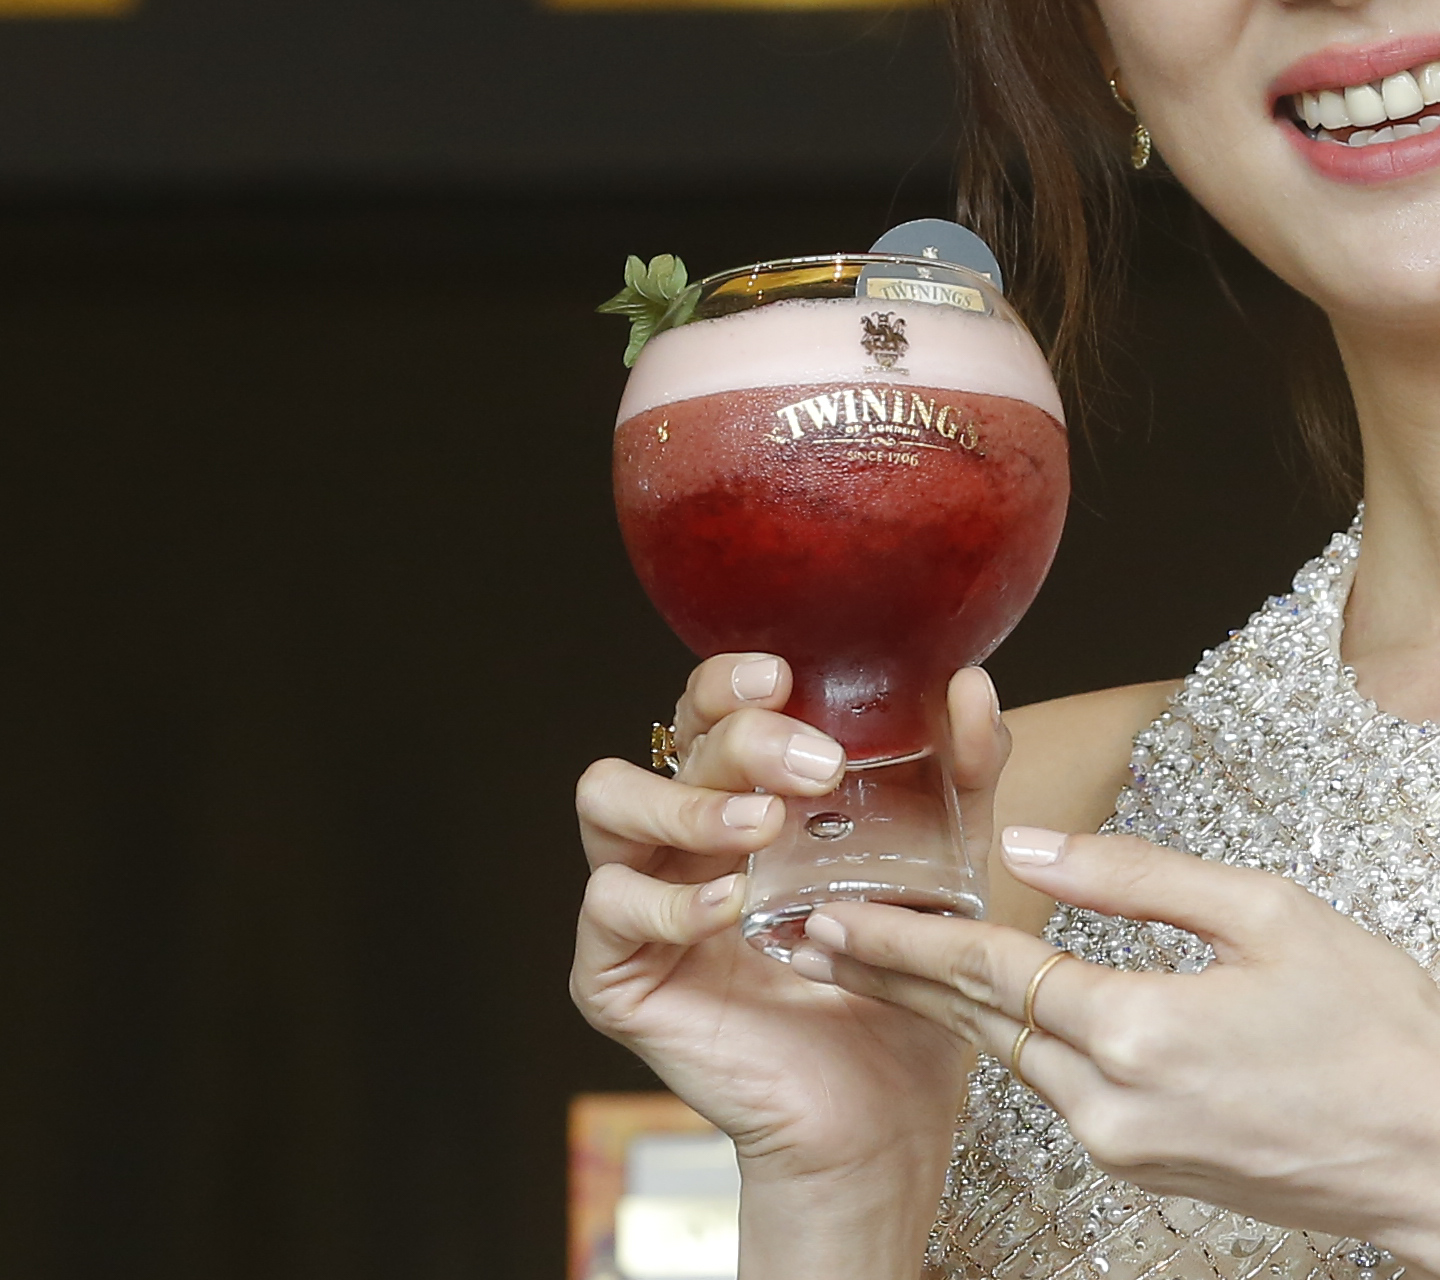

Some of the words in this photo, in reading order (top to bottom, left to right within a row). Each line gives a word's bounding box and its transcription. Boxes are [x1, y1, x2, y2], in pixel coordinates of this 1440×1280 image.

[879, 281, 971, 308] TWININGS
[777, 388, 979, 450] TWININGS
[868, 424, 920, 437] LONDON
[846, 450, 883, 463] SINCE
[888, 451, 919, 467] 1706
